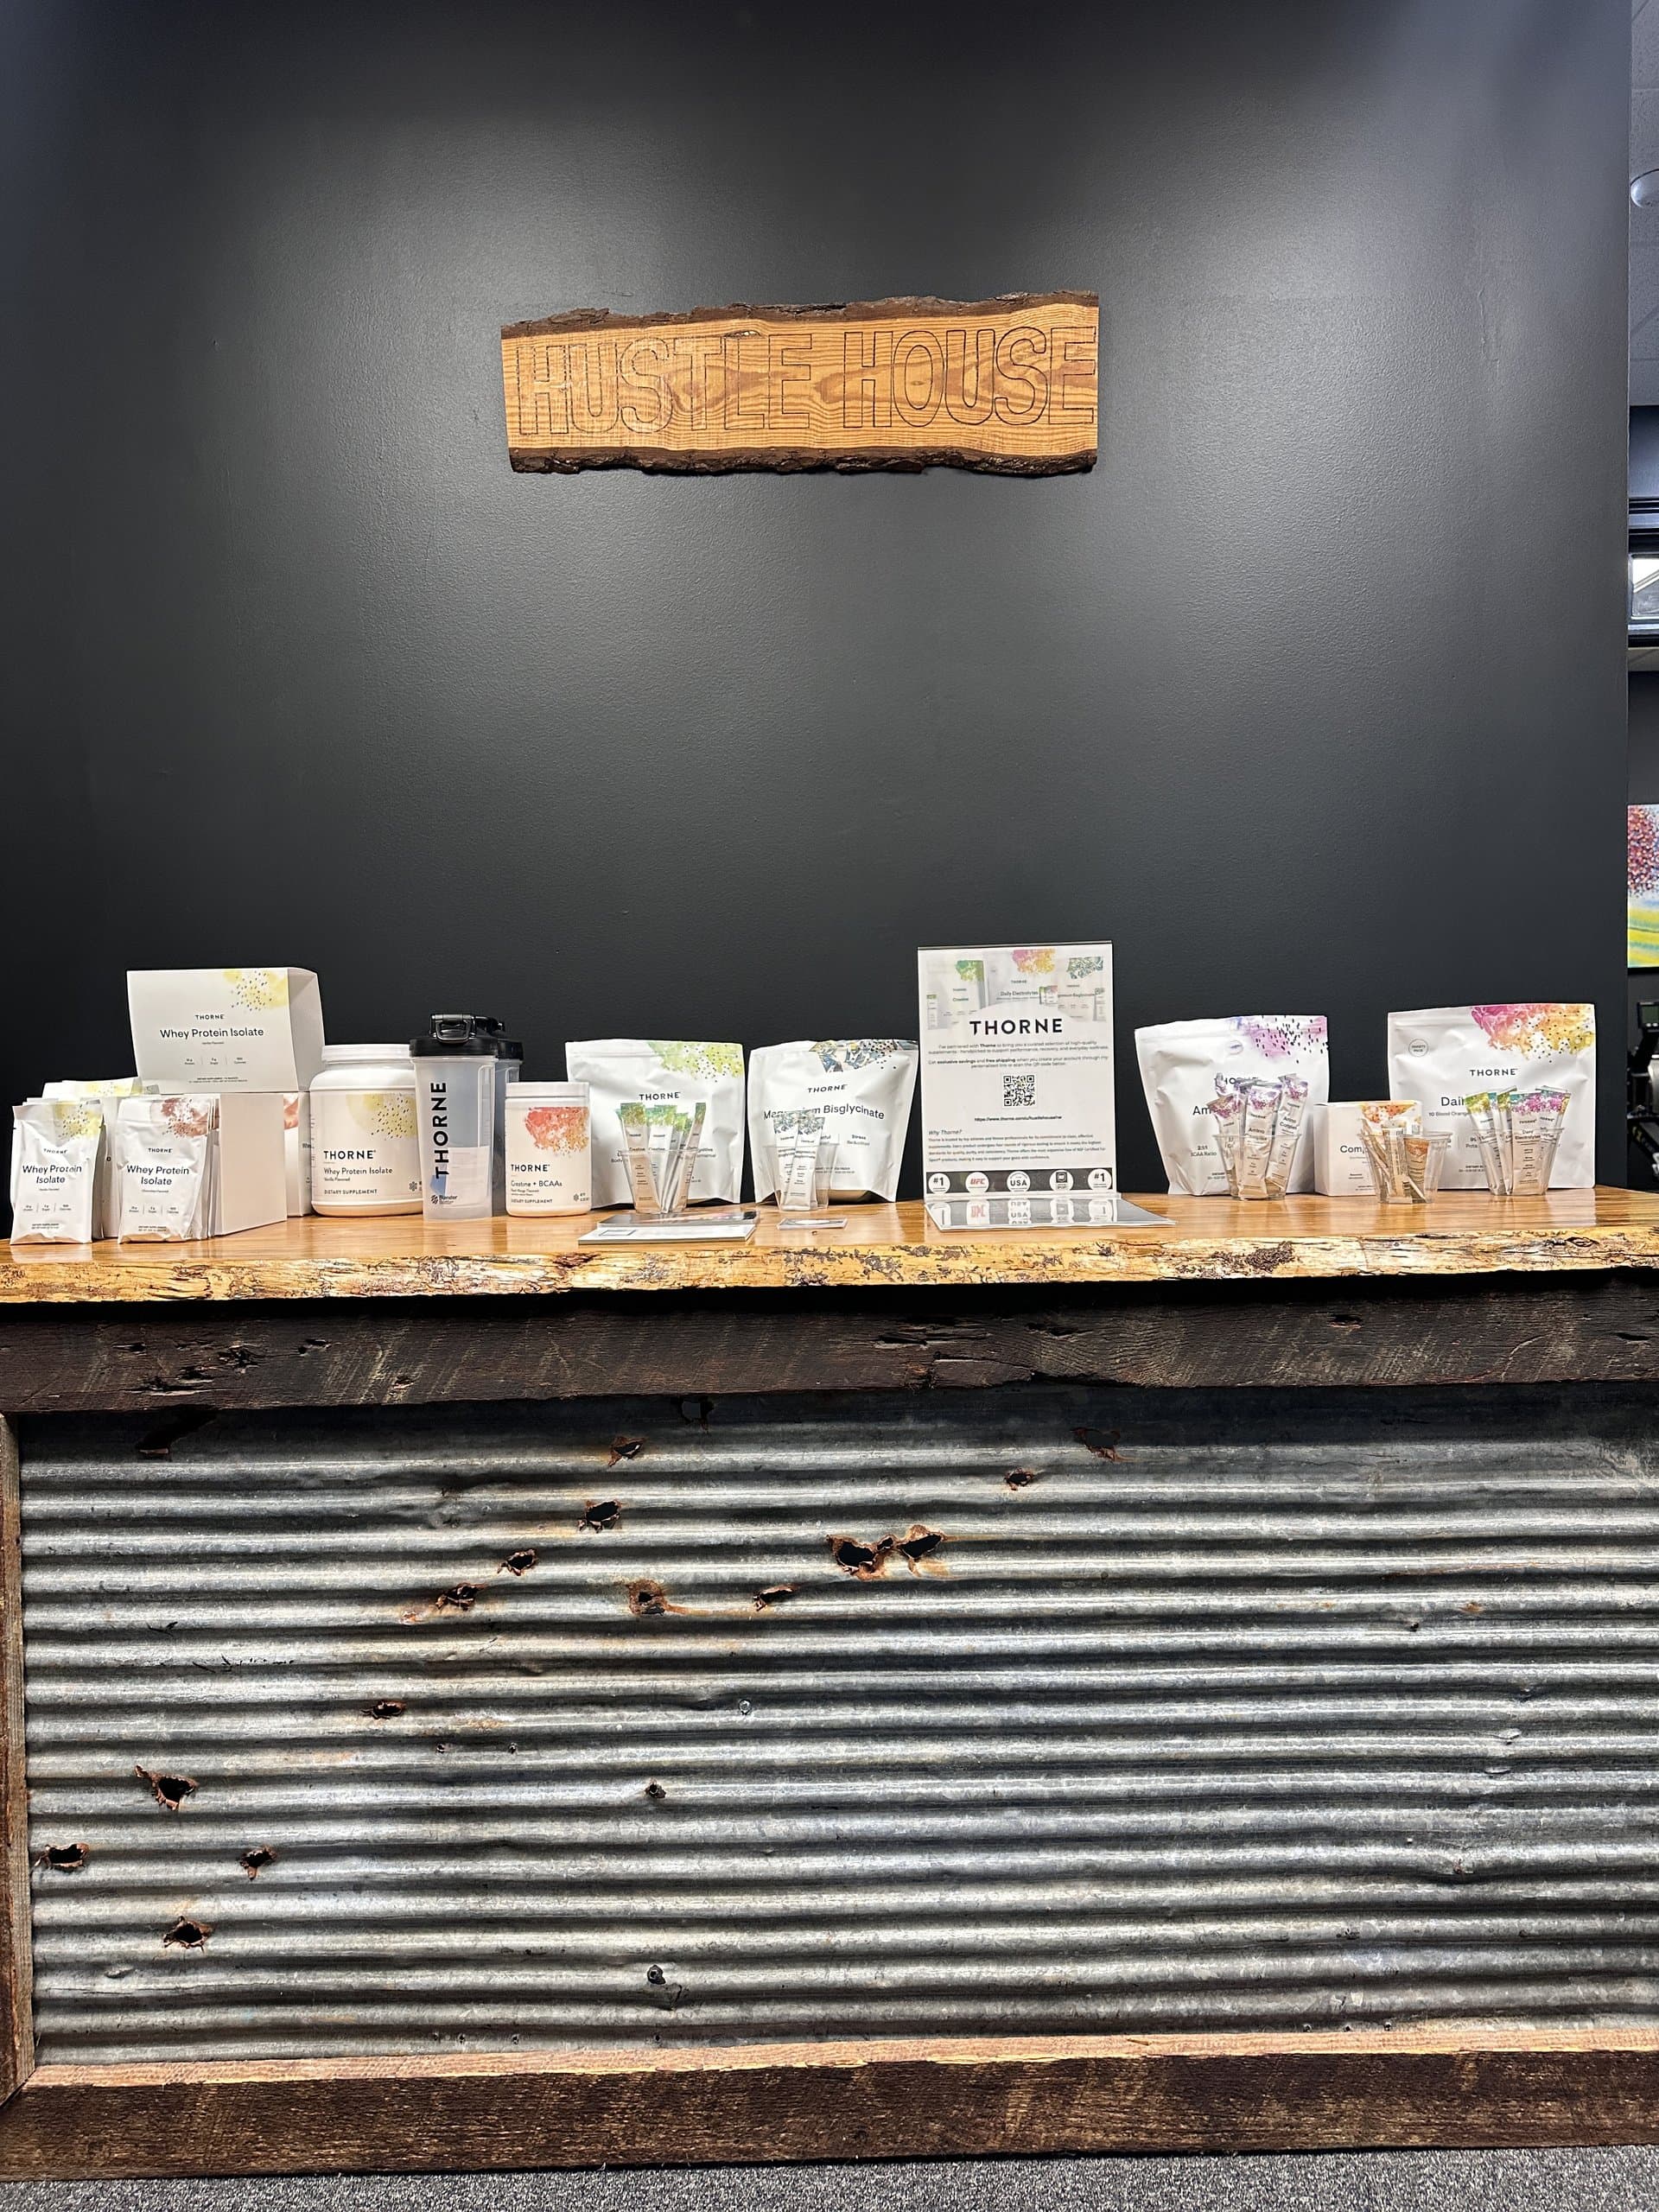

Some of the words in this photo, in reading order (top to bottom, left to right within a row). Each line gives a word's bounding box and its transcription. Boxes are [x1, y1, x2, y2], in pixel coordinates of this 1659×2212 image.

[515, 334, 812, 435] HUSTLE
[843, 326, 1096, 428] HOUSE
[969, 1018, 1063, 1035] THORNE
[160, 1029, 189, 1039] Whey
[192, 1028, 228, 1038] Protein
[230, 1027, 264, 1036] Isolate
[808, 1084, 847, 1093] THORNE
[639, 1092, 680, 1100] THORNE
[1441, 1096, 1465, 1106] Dail
[823, 1103, 885, 1120] Bisglycinate
[431, 1082, 450, 1179] THORNE
[1340, 1145, 1368, 1154] Comp
[324, 1150, 374, 1159] THORNE
[22, 1165, 48, 1175] Whey
[50, 1165, 82, 1173] Protein
[127, 1165, 154, 1175] Whey
[156, 1166, 189, 1175] Protein
[324, 1168, 340, 1177] Whey
[141, 1177, 172, 1185] Isolate
[933, 1177, 944, 1186] #1
[1094, 1173, 1105, 1182] #1
